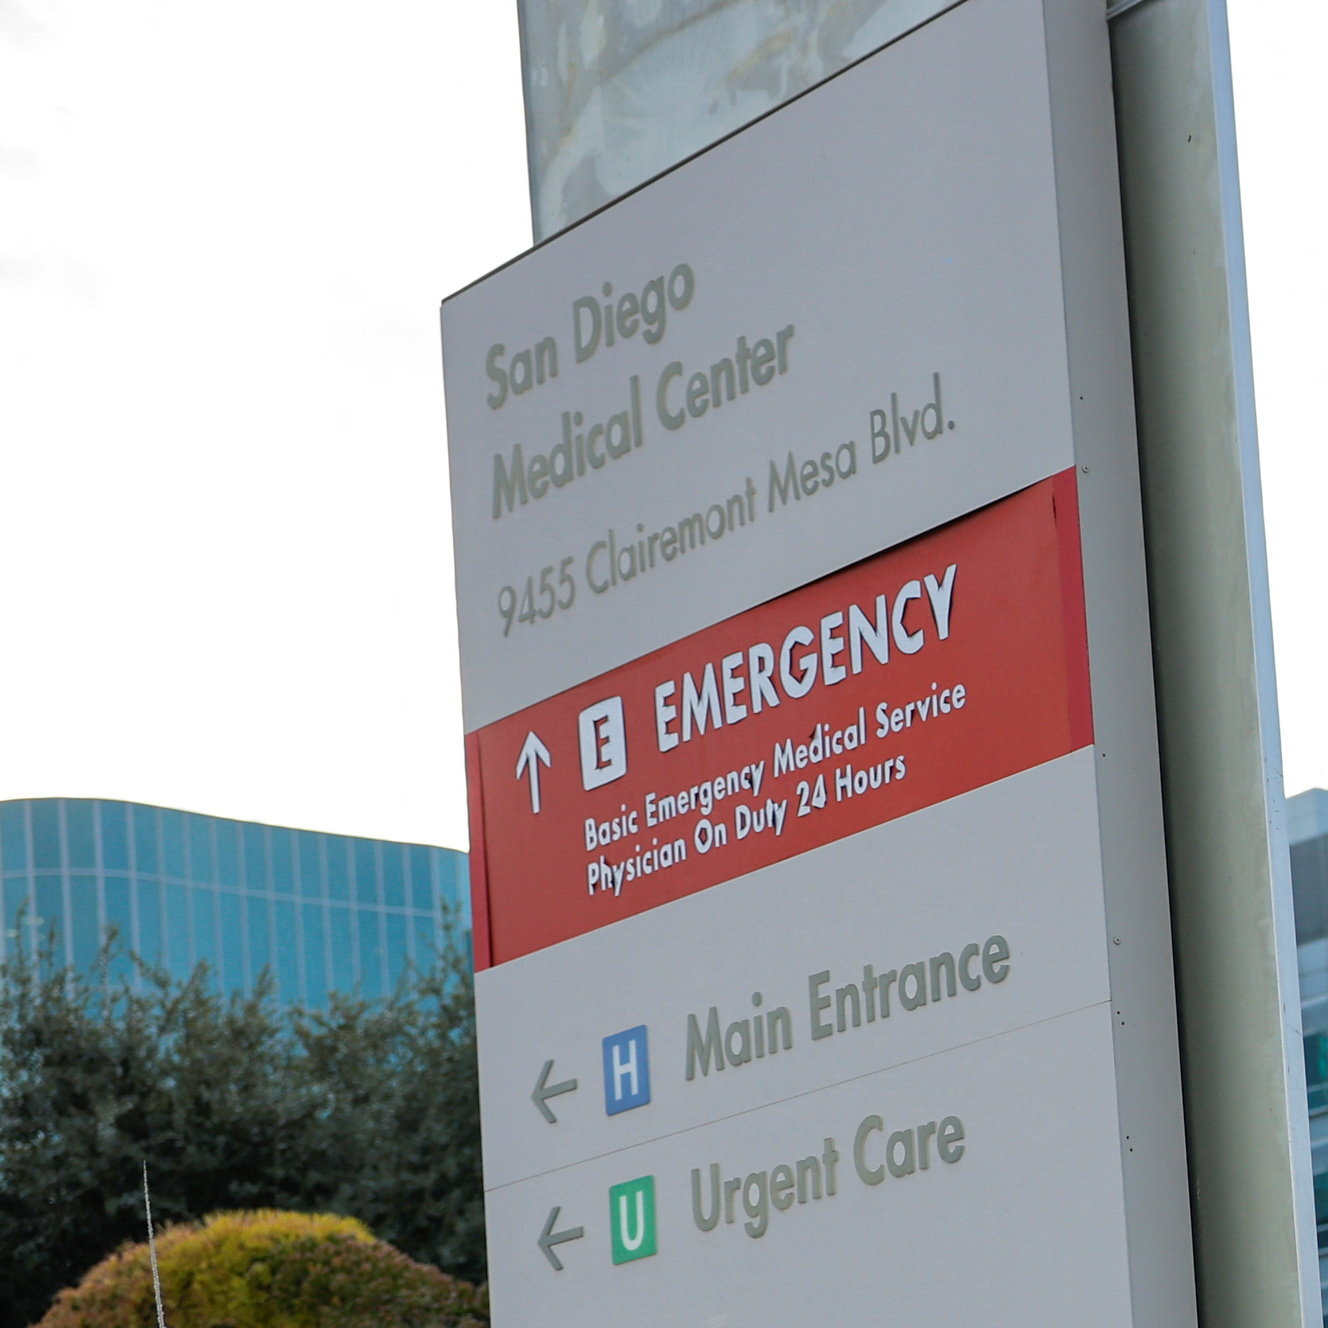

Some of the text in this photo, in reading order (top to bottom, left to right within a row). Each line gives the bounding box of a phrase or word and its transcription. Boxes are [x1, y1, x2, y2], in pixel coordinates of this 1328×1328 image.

[486, 262, 696, 409] San Diego
[491, 325, 795, 519] Medical Center
[497, 372, 957, 638] 9455 Clairemont Mesa Blvd.
[592, 564, 958, 771] E EMERGENCY
[583, 680, 967, 852] Basic Emergency Medical Service
[586, 755, 907, 896] Physician On Duty 24 Hours
[611, 934, 1011, 1102] H Main Entrance
[619, 1114, 966, 1253] U Urgent Care
